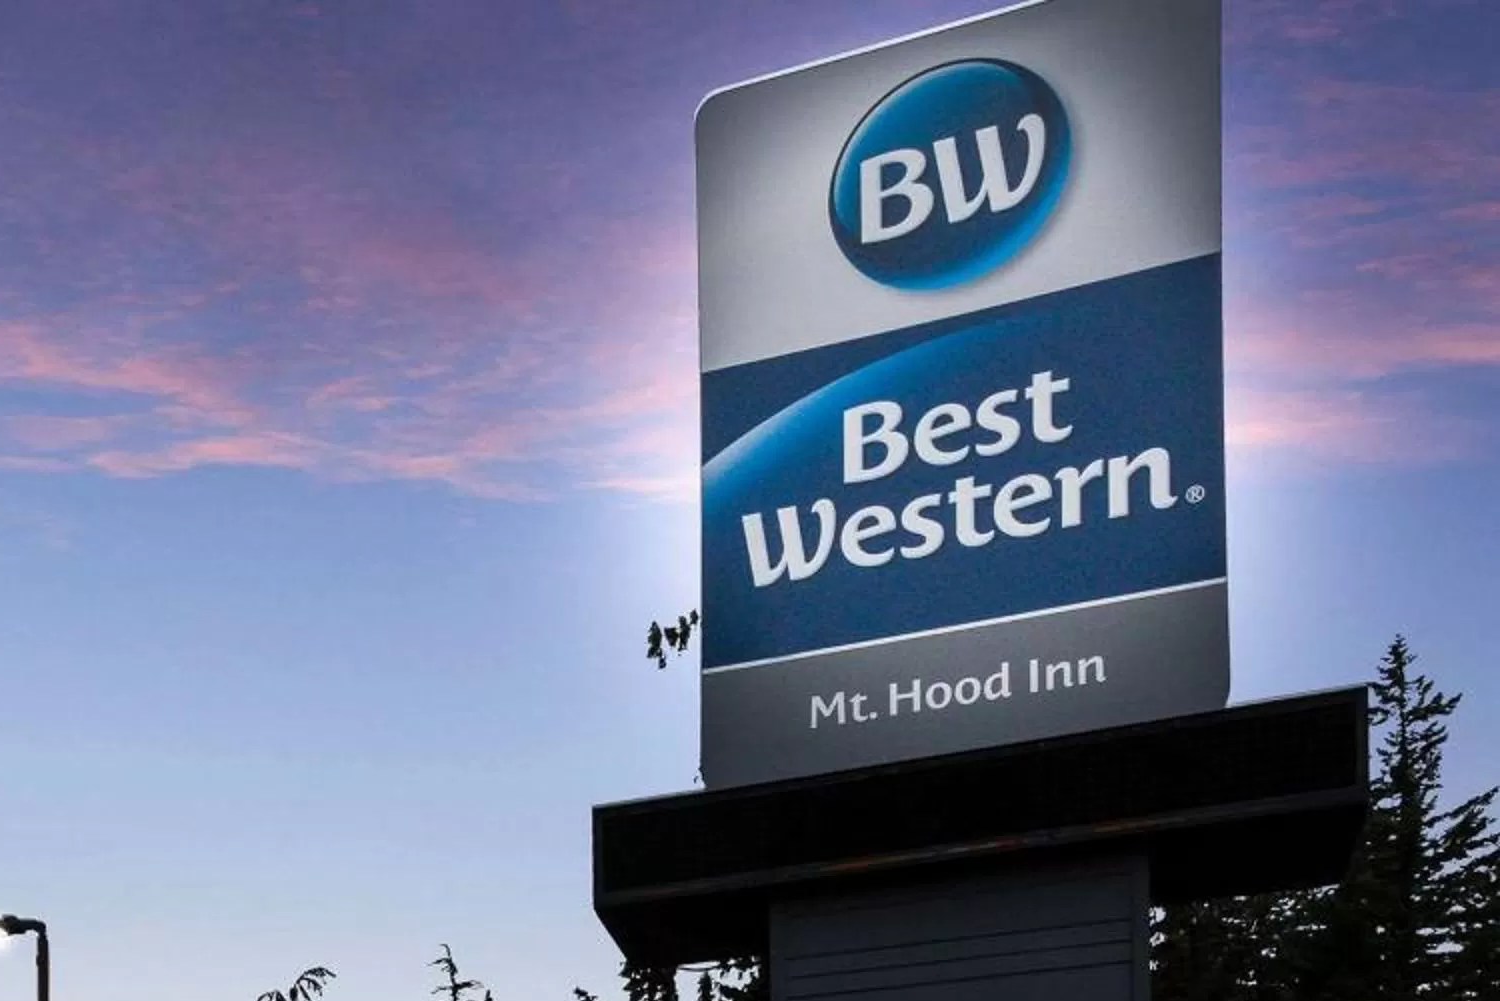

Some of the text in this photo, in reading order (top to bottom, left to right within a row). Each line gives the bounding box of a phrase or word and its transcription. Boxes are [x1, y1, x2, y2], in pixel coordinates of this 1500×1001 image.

[859, 113, 1047, 245] BW
[842, 369, 1074, 485] Best
[809, 654, 1108, 729] Mt. Hood Inn
